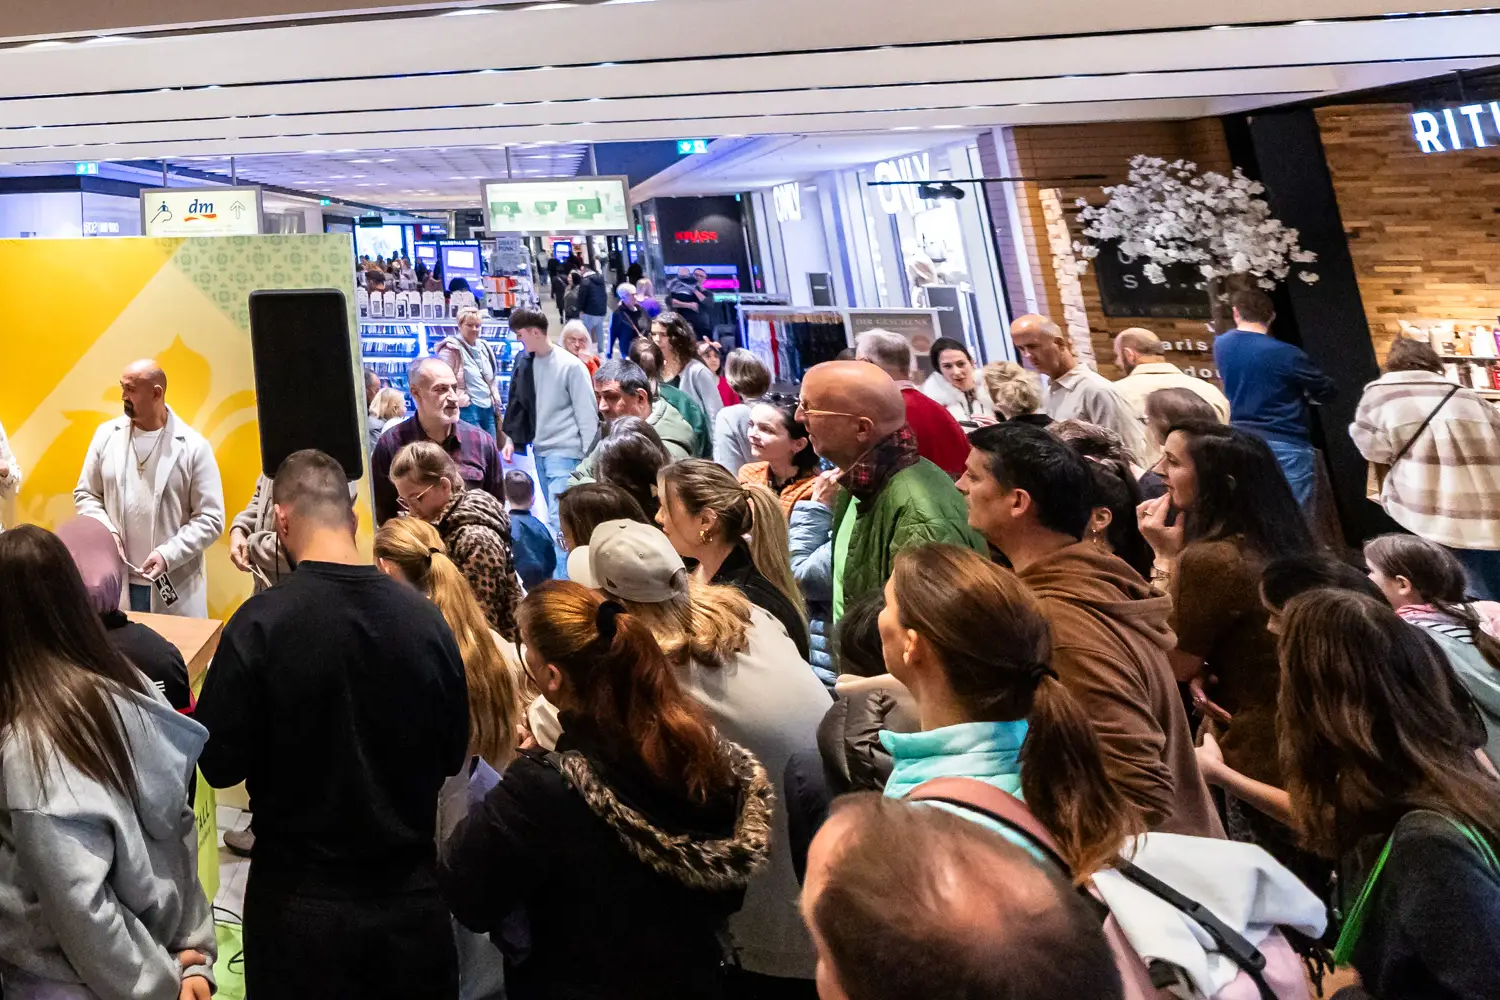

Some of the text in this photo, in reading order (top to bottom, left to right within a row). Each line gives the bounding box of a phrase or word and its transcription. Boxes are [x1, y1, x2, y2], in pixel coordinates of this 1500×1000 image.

[875, 153, 933, 214] ONLY
[188, 199, 213, 213] dm
[773, 182, 801, 222] ONLY
[675, 230, 718, 243] KRASS
[1162, 338, 1208, 351] aris
